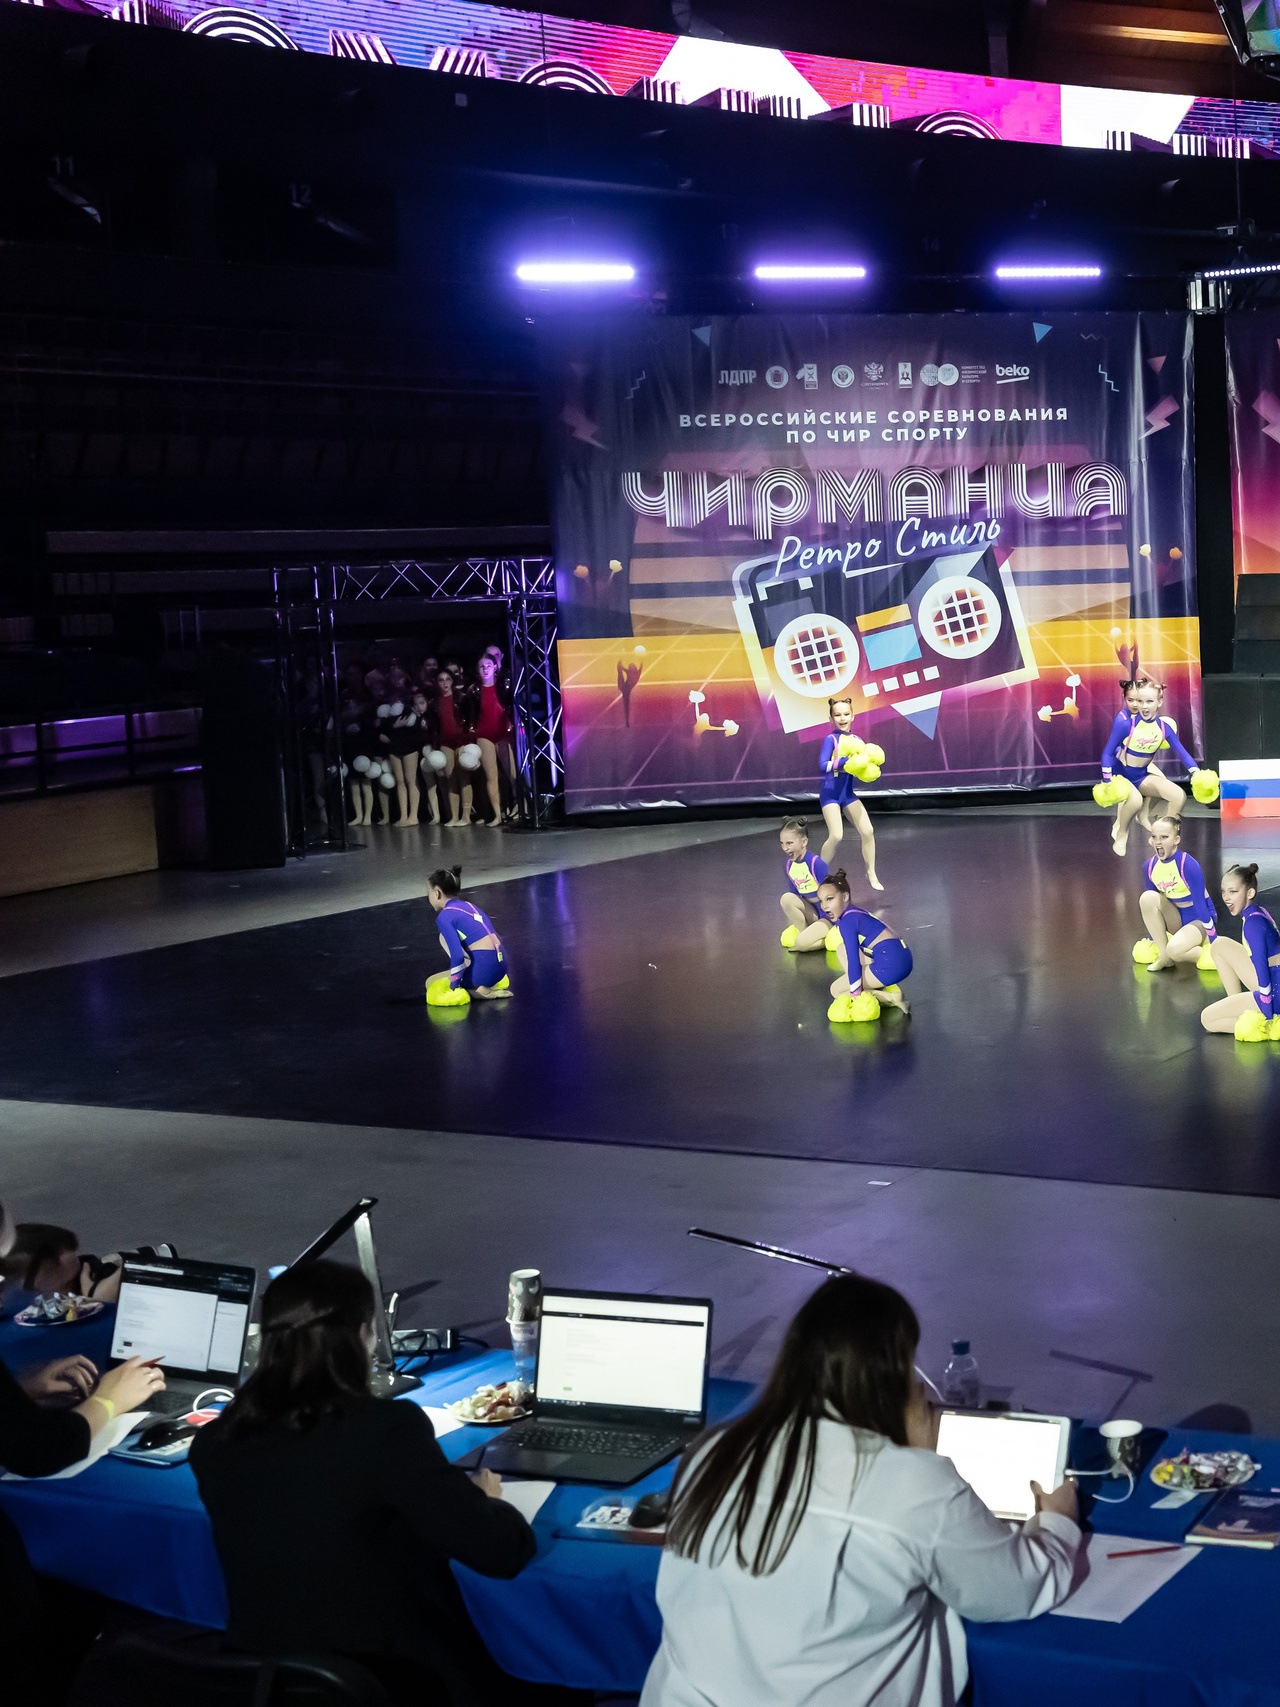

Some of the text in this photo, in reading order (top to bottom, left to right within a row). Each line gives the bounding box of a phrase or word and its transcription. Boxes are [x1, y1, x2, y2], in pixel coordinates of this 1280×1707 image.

[718, 369, 757, 386] ЛДПР
[994, 363, 1031, 377] beko
[679, 407, 1068, 428] ВСЕРОССИЙСКИЕ СОРЕВНОВАНИЯ
[786, 427, 968, 444] ПО ЧИР СПОРТУ
[774, 516, 1002, 579] Ретро Стиль
